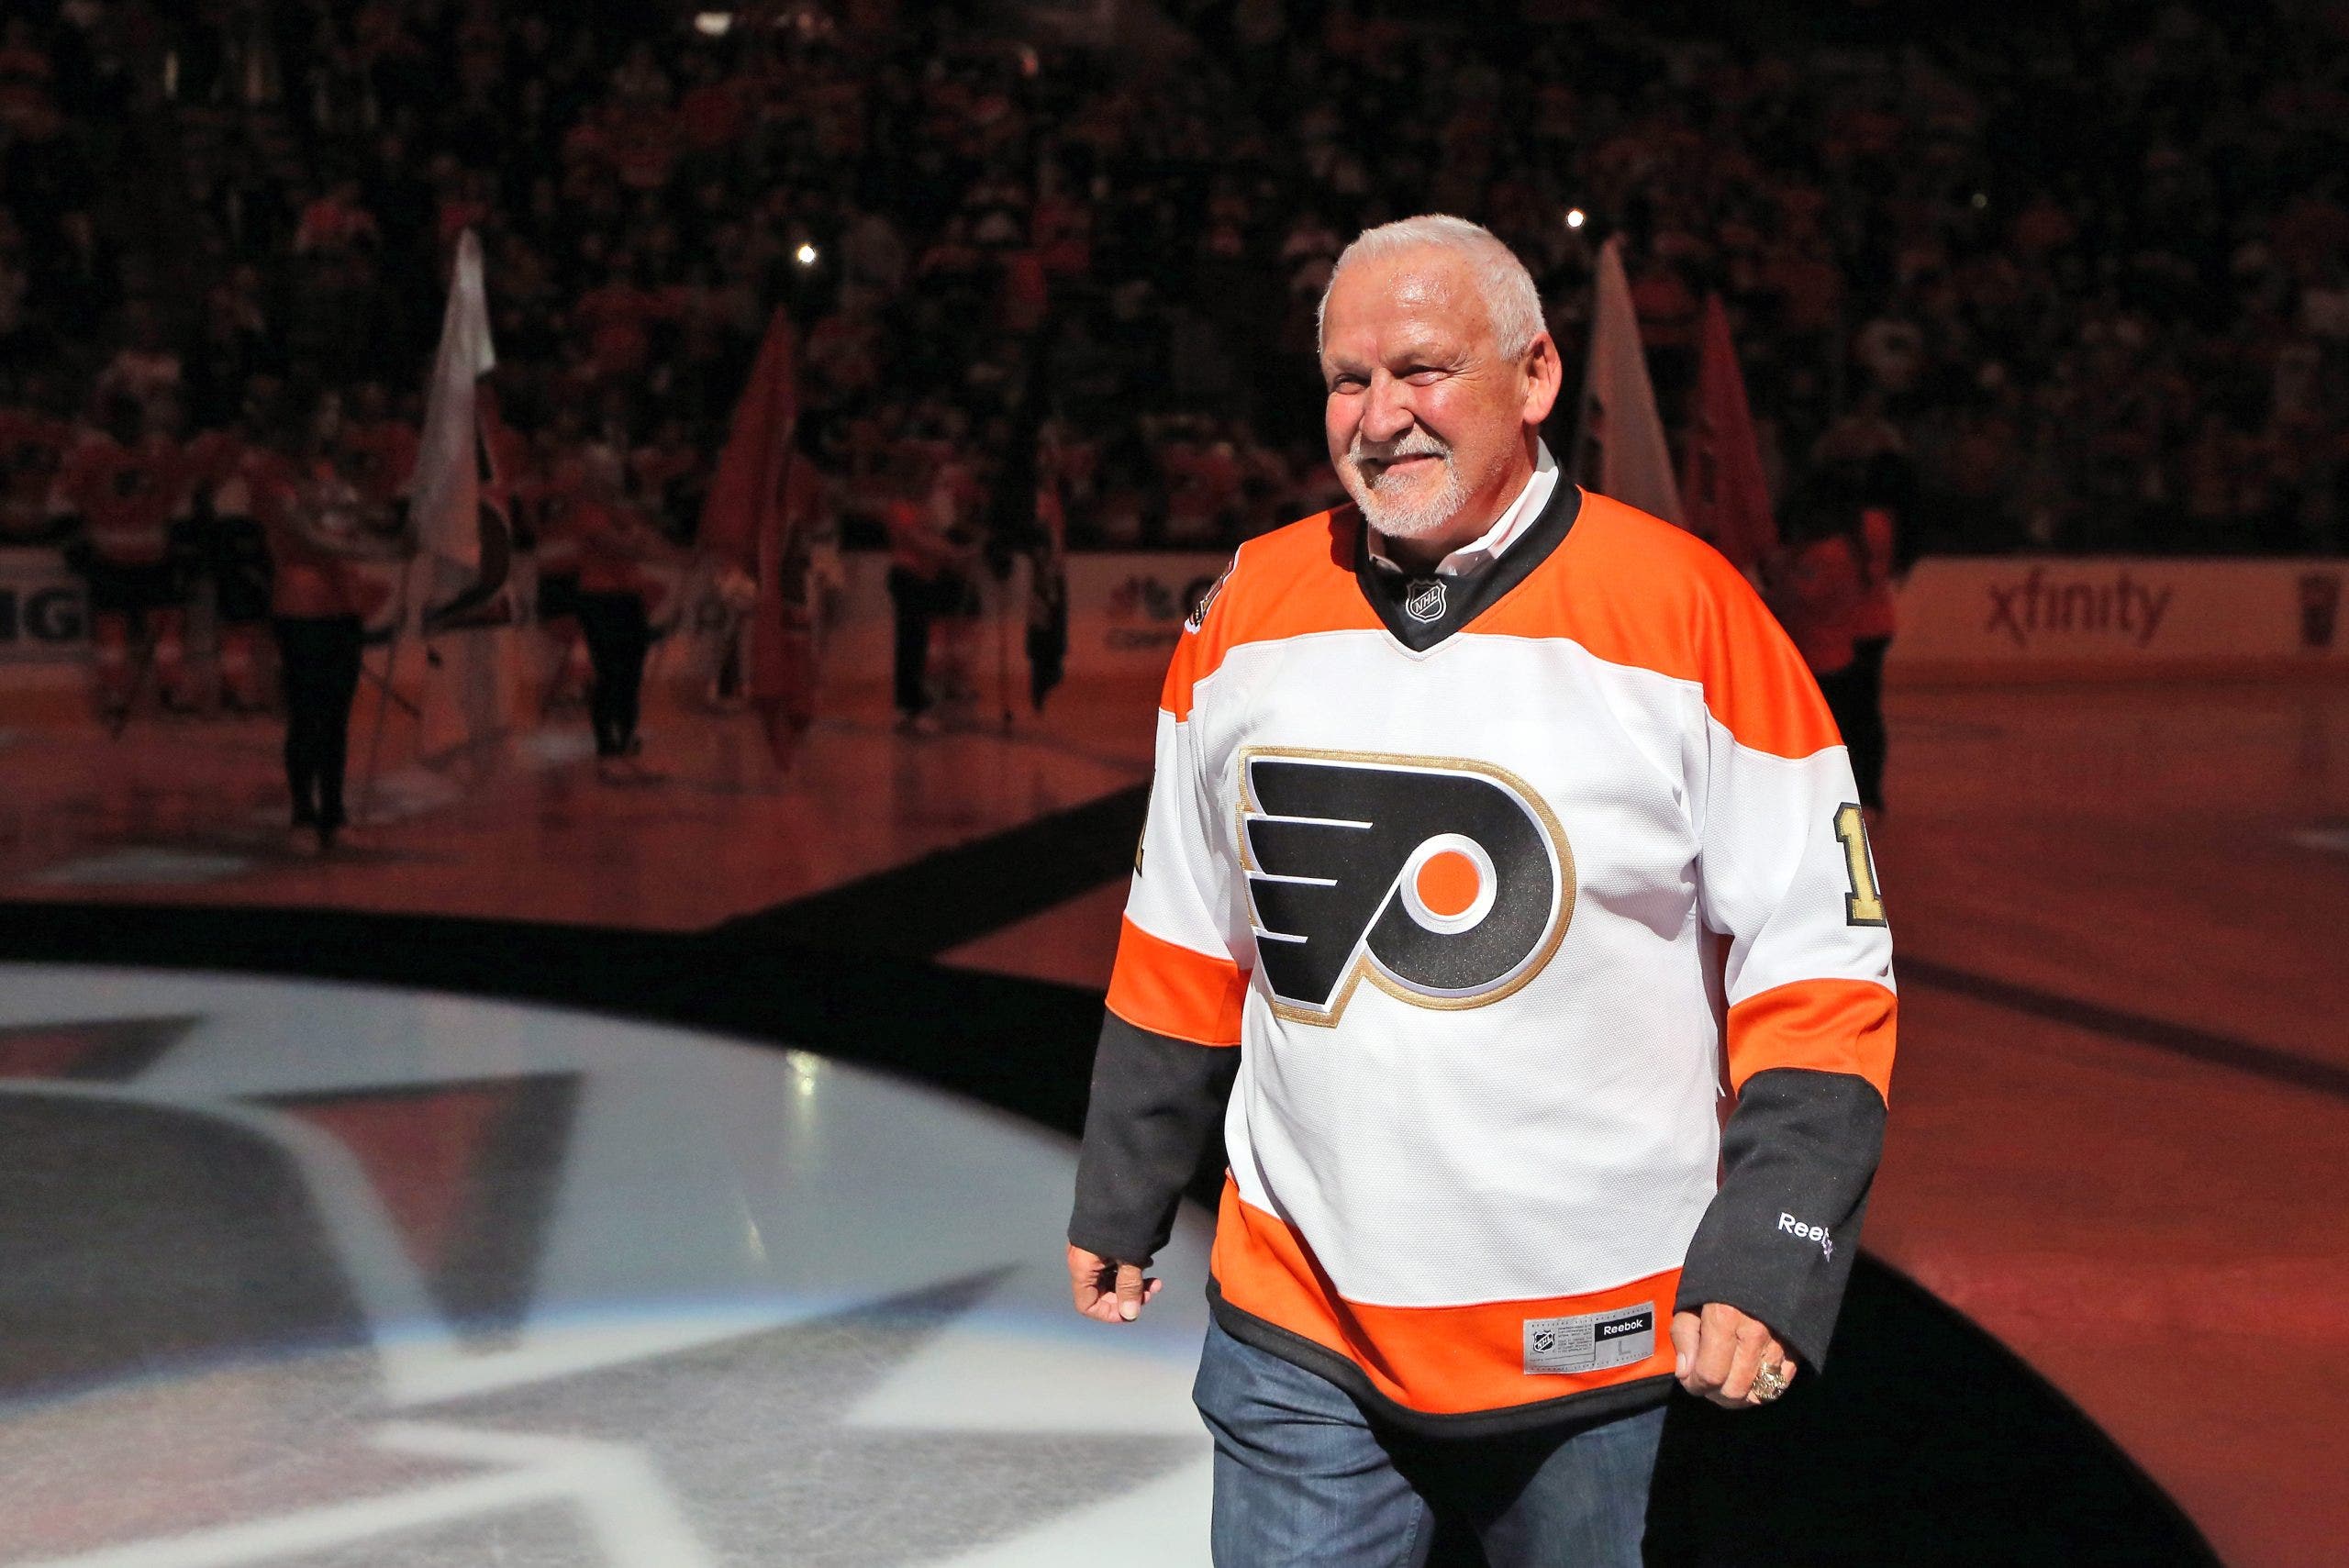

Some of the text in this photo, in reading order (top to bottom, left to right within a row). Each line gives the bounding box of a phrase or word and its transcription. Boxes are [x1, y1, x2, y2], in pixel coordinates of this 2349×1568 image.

[1415, 590, 1439, 613] NHL
[1985, 565, 2174, 648] xfinity
[1833, 802, 1887, 928] 1
[1603, 1318, 1643, 1336] Reebok
